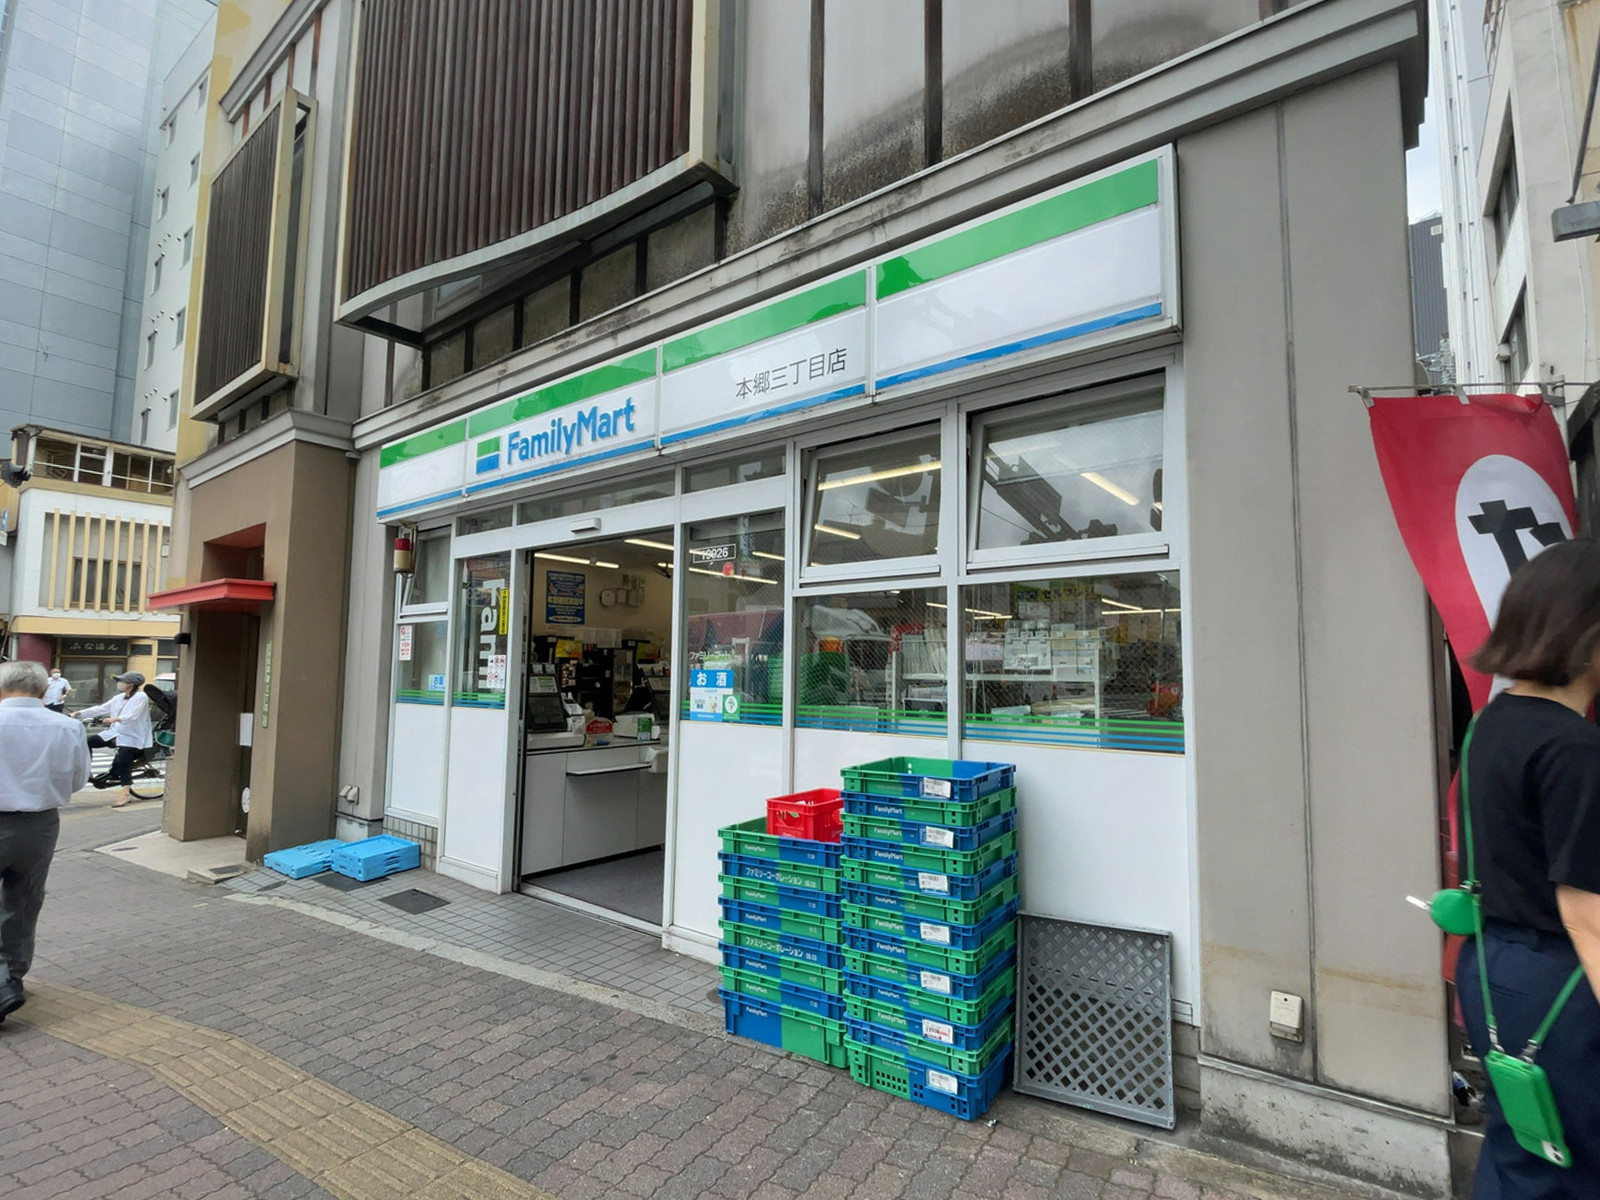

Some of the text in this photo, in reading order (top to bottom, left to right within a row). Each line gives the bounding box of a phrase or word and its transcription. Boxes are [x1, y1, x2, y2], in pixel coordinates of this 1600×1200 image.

[736, 348, 847, 399] 本郷三丁目店
[507, 397, 635, 465] FamilyMart
[696, 671, 727, 687] お酒
[874, 805, 903, 815] FamilyMart
[873, 827, 902, 837] FamilyMart
[874, 850, 904, 861] FamilyMart
[875, 919, 904, 931] FamilyMart
[876, 942, 906, 955] FamilyMart
[877, 1011, 907, 1026] FamilyMart
